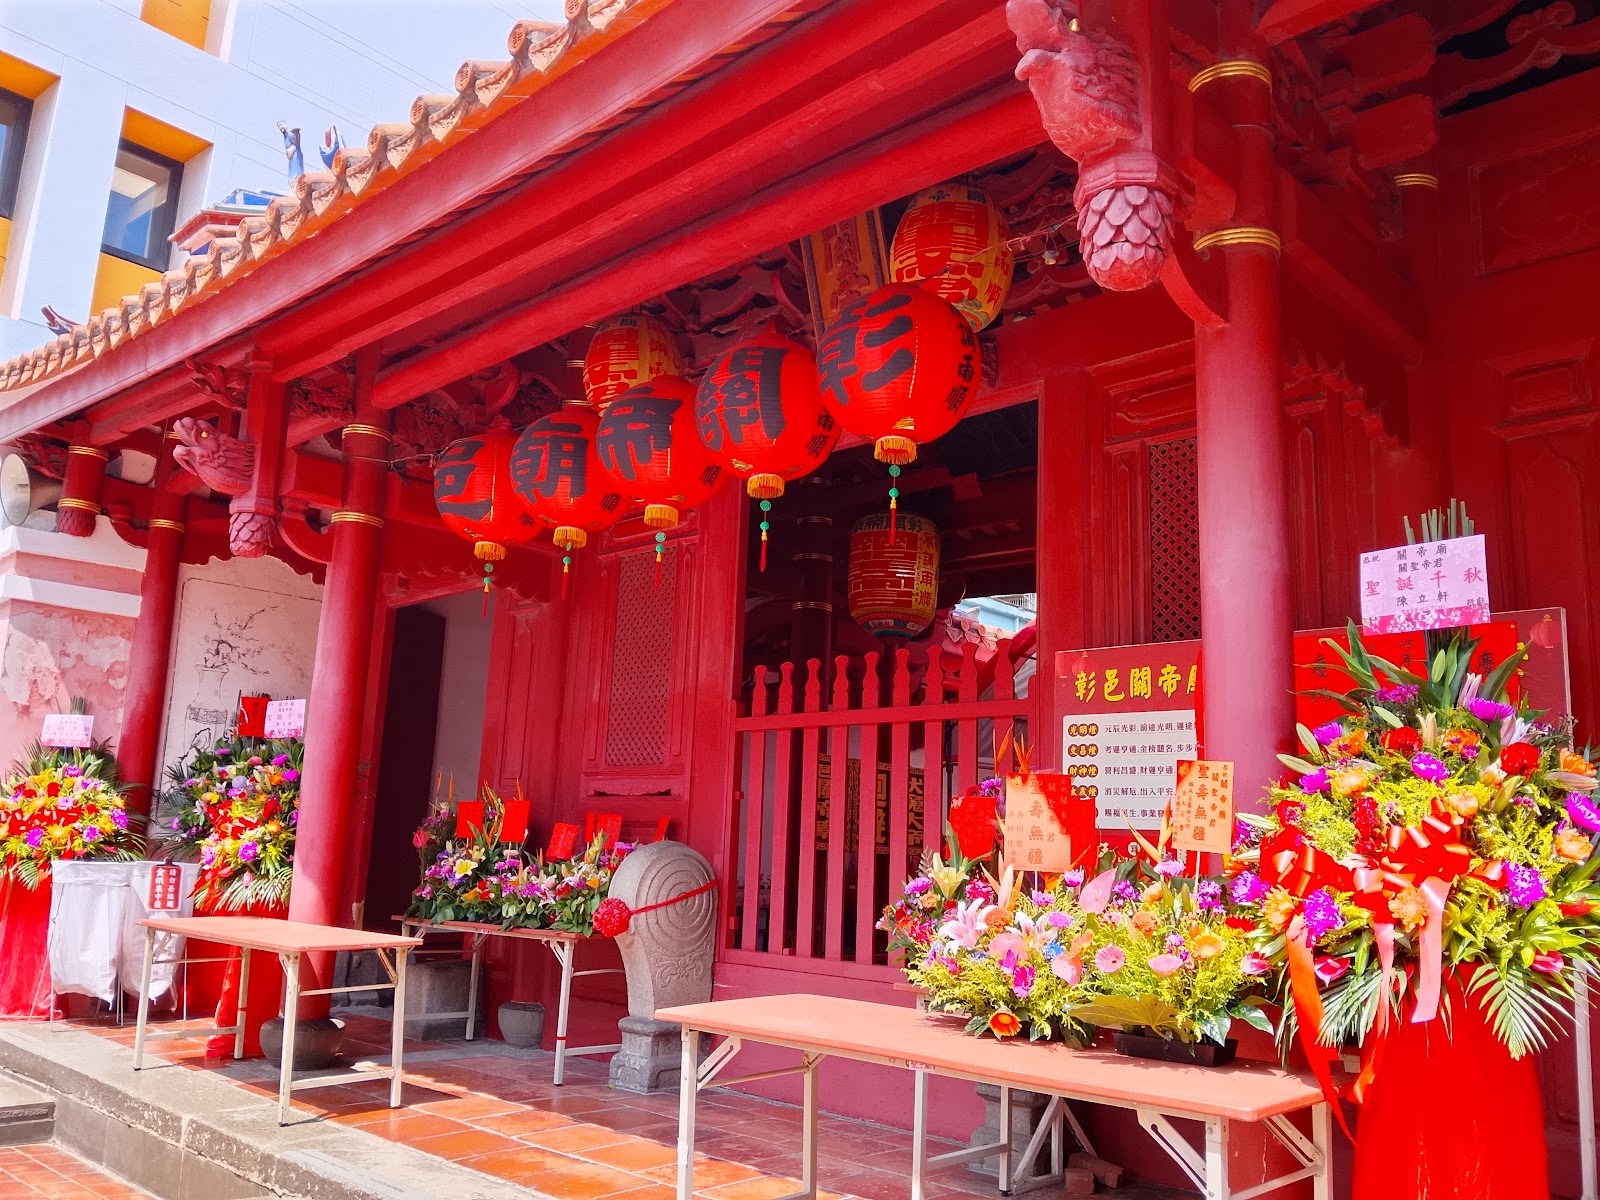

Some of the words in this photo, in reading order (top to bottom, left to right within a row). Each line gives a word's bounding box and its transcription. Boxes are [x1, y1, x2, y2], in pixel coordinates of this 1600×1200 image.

[1396, 543, 1447, 561] 關帝廟
[1398, 557, 1444, 573] 關聖帝君
[1365, 566, 1484, 597] 聖誕千秋
[1396, 591, 1448, 607] 陳立軒
[1192, 764, 1210, 841] 聖壽無疆
[1027, 778, 1045, 865] 聖壽無疆
